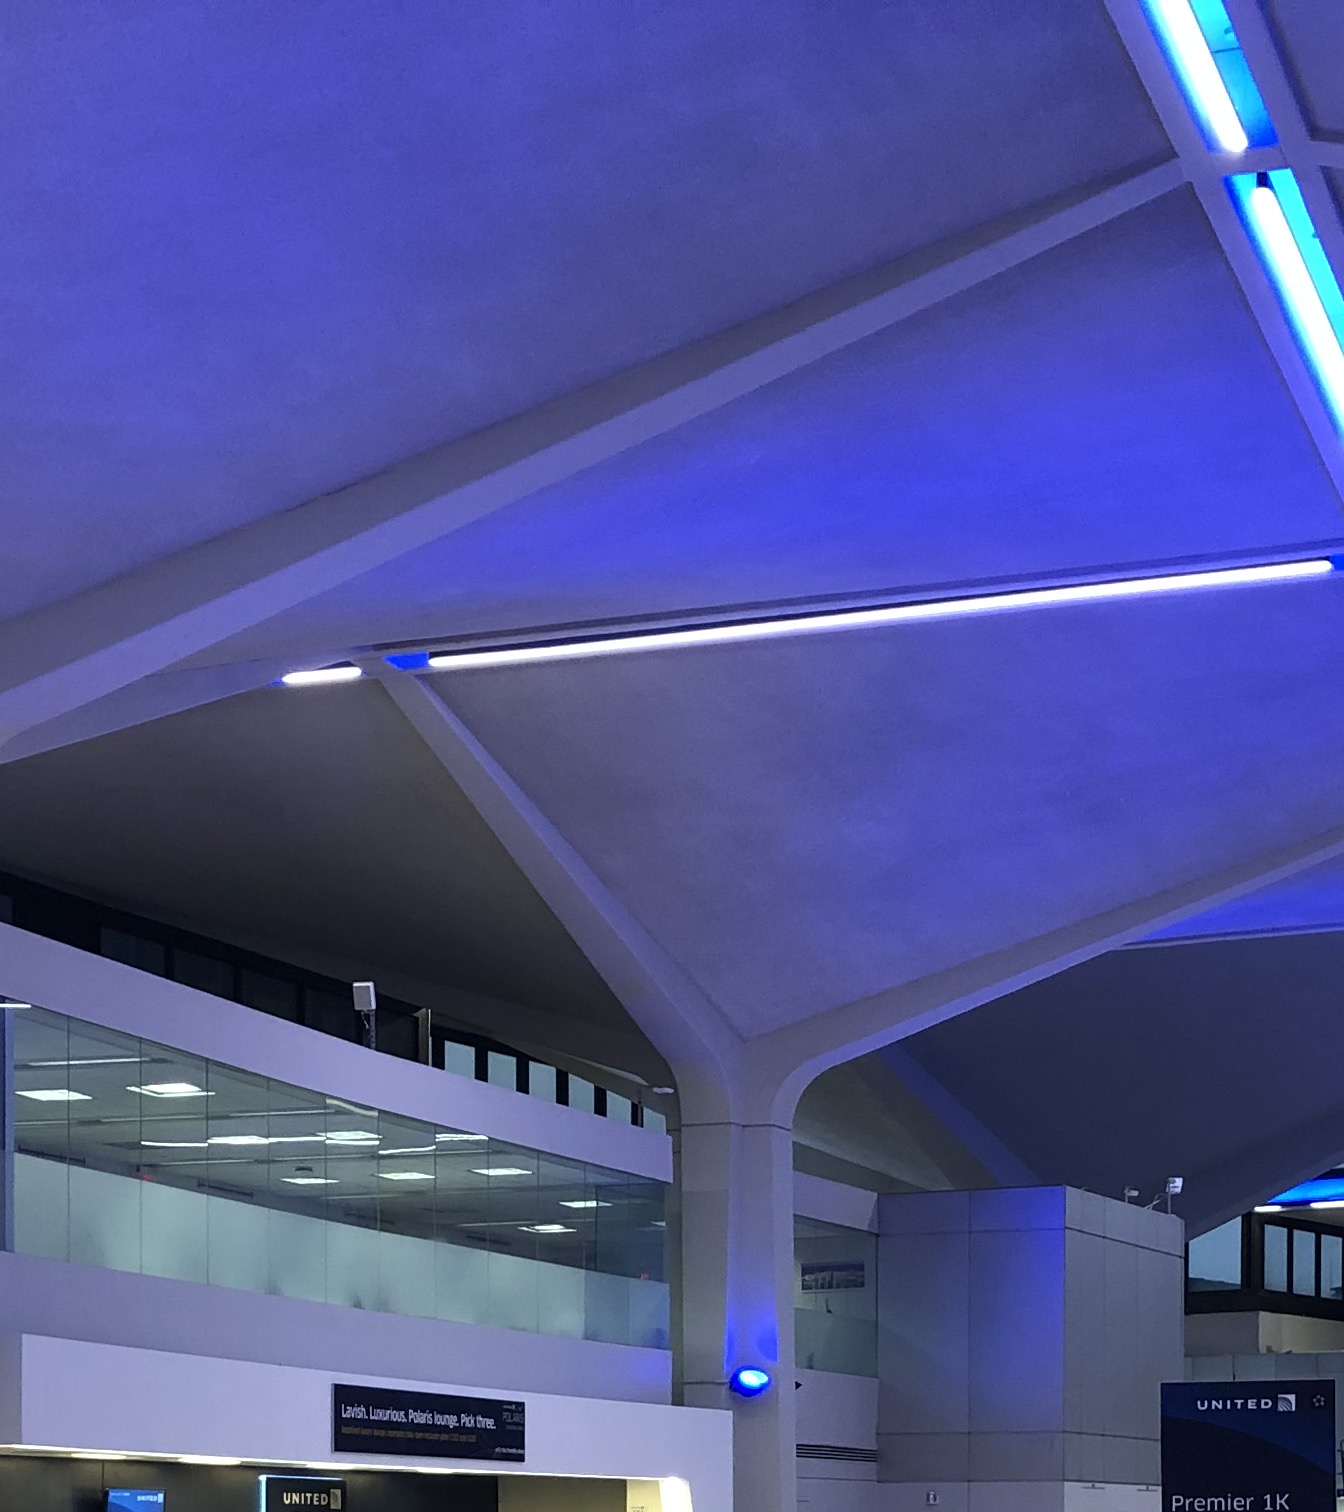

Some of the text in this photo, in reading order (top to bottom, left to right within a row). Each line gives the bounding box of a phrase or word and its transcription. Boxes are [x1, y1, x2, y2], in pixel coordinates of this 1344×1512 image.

[1197, 1399, 1273, 1410] UNITED
[341, 1404, 496, 1429] Lavish. Luxurious. Polaris lounge. Pick three.
[283, 1492, 328, 1505] UNITED
[1171, 1493, 1290, 1512] Premier 1K
